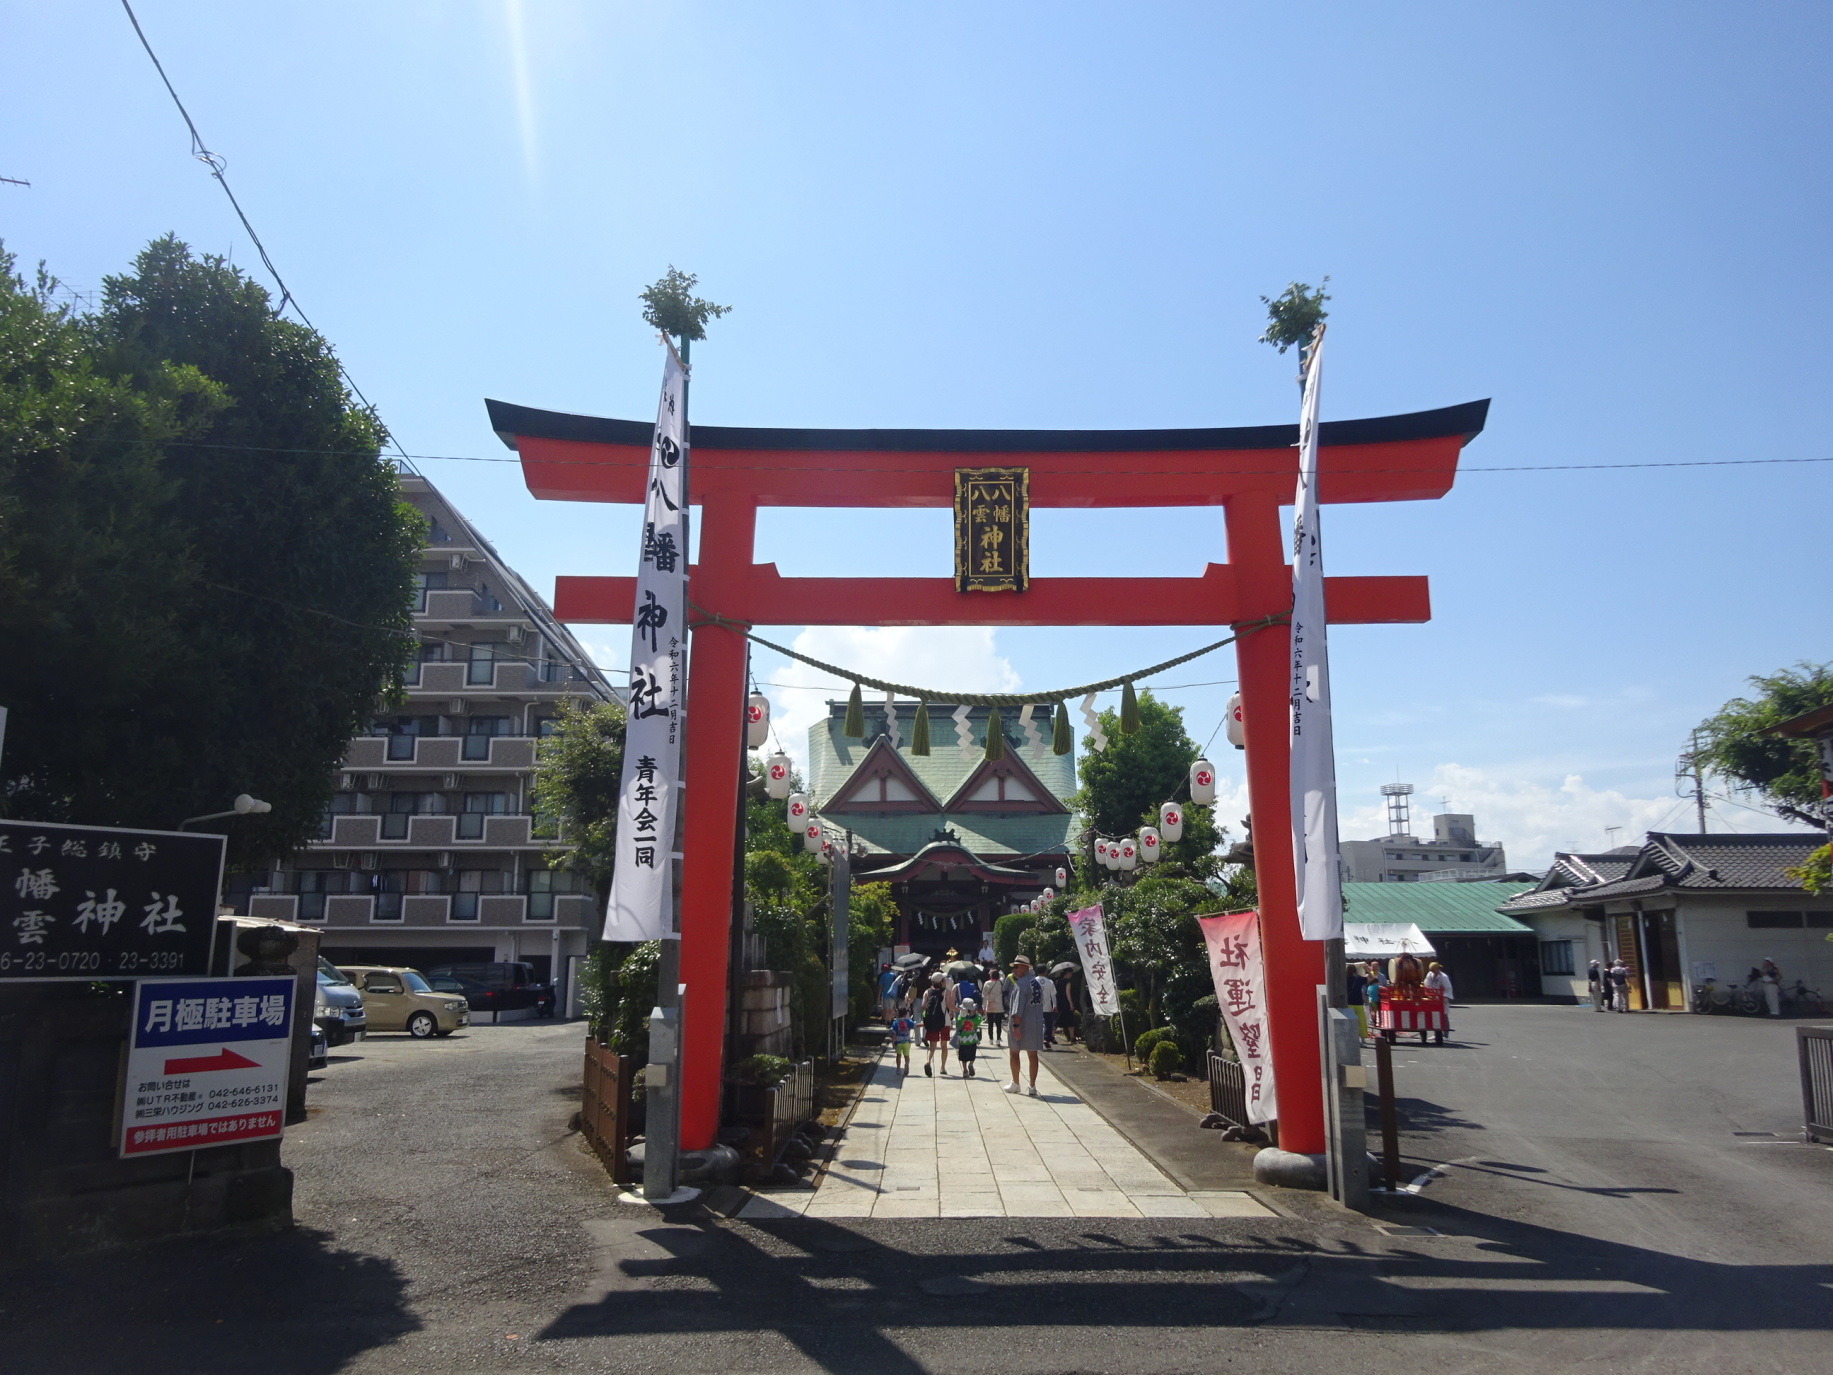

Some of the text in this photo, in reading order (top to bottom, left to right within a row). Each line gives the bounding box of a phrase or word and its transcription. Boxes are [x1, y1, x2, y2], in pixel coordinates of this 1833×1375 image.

[971, 485, 991, 523] 八雲
[991, 485, 1011, 523] 八幡
[980, 524, 1004, 574] 神社
[630, 477, 680, 720] 八幡神社
[668, 636, 680, 745] 令和六年十二月吉日
[633, 755, 659, 869] 青年会一同
[72, 888, 187, 936] 神社
[1345, 935, 1395, 945] 神社
[145, 995, 286, 1033] 月極駐車場
[138, 1079, 191, 1093] お問い合せは
[208, 1095, 279, 1111] 042-626-3374
[209, 1084, 279, 1098] 042-646-6131
[133, 1115, 276, 1145] 参拝者用駐車場ではありません
